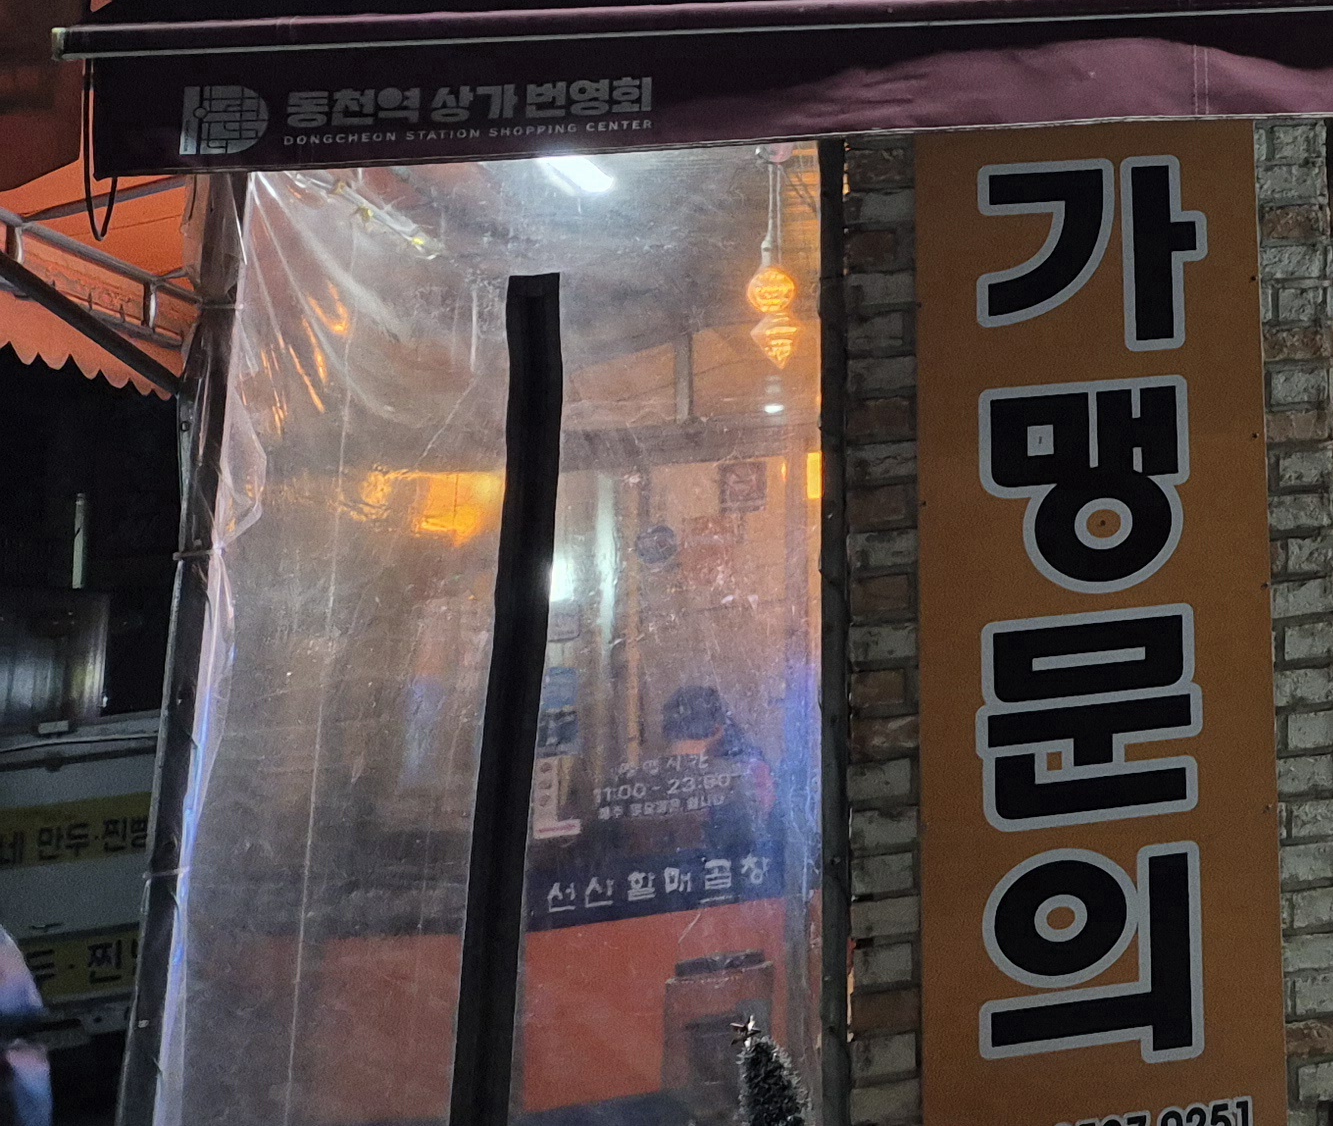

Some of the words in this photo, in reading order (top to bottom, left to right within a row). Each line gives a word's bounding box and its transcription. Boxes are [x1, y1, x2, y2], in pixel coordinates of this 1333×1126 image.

[286, 86, 421, 128] 동천역
[431, 83, 518, 124] 상가
[525, 75, 653, 119] 번영회
[283, 131, 396, 147] DONGCHEON
[405, 127, 480, 142] STATION
[488, 123, 578, 137] SHOPPING
[586, 119, 653, 133] CENTER
[976, 154, 1207, 1064] 가맹문의
[546, 875, 615, 913] 선산
[627, 866, 693, 902] 할매
